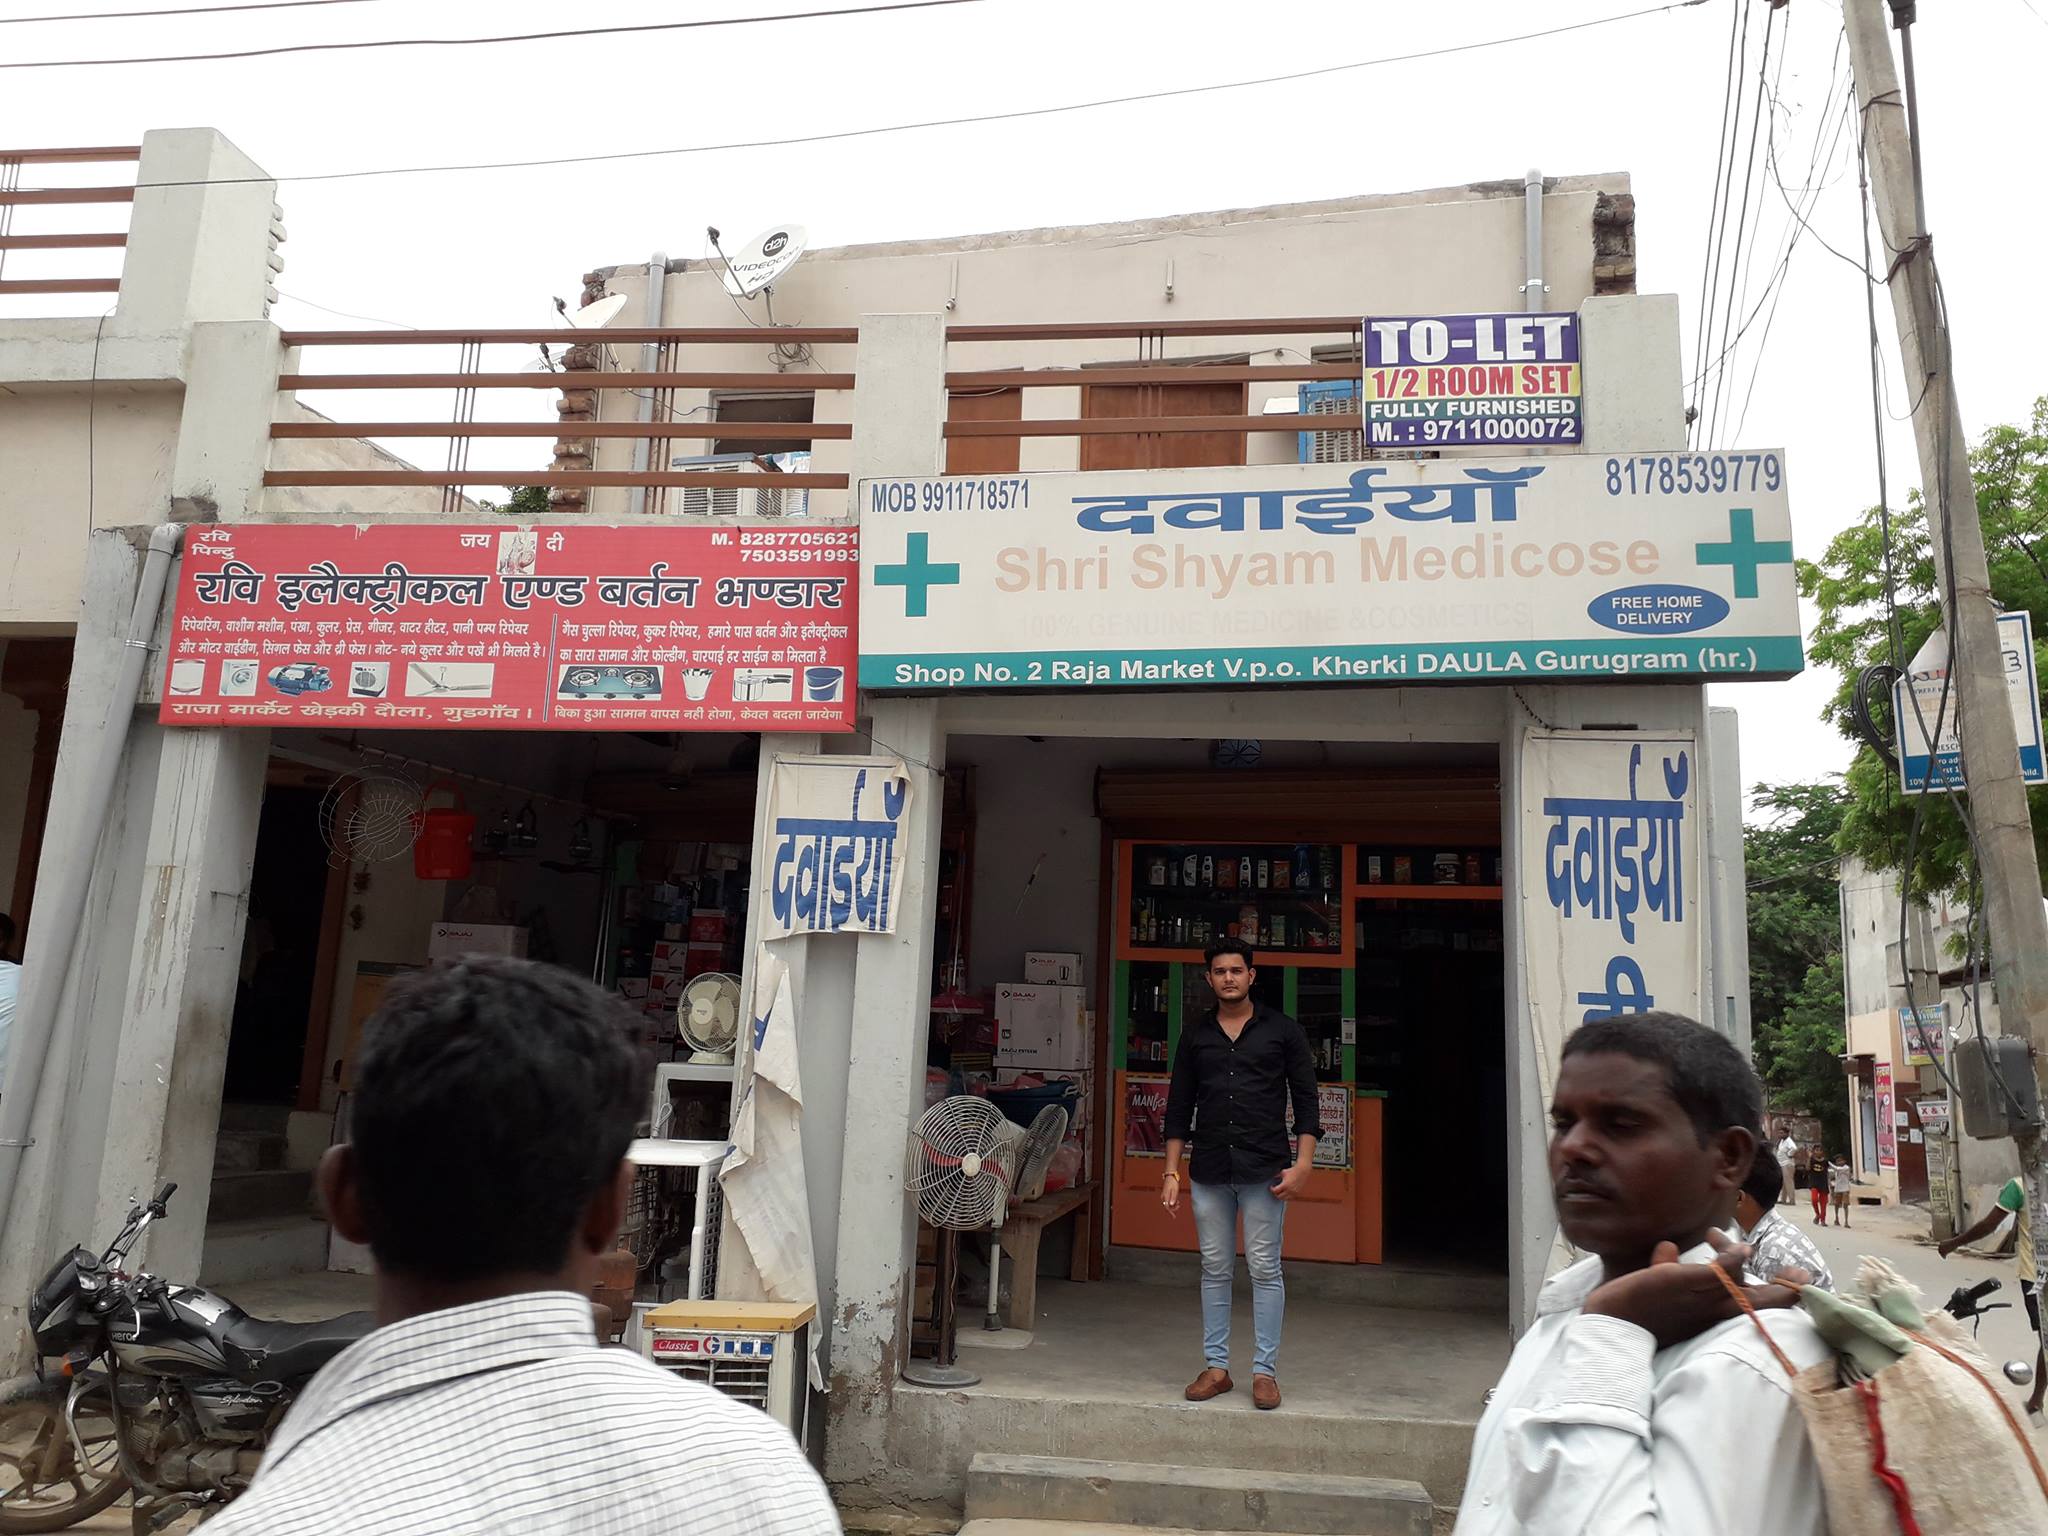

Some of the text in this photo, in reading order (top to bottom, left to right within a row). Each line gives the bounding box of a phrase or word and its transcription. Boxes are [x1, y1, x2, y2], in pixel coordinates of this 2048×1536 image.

[1371, 316, 1571, 364] TO-LET
[1372, 364, 1573, 398] 1/2 ROOM SET
[1370, 399, 1576, 418] FULLY FURNISHED
[1423, 418, 1576, 441] 9711000072
[1606, 453, 1780, 496] 8178539779
[872, 479, 1029, 513] MOB 9911718571
[199, 529, 232, 543] रवि
[460, 533, 492, 549] जय
[740, 532, 858, 546] 8287705621
[740, 549, 859, 562] 7503591993
[995, 534, 1660, 600] Shri Shyam Medicose
[194, 561, 265, 604] रवि
[502, 575, 588, 610] एण्ड
[597, 561, 700, 609] बर्तन
[715, 576, 846, 609] भण्डार
[1612, 595, 1703, 610] FREE HOME
[453, 618, 473, 634] पानी
[1616, 611, 1693, 626] DELIVERY
[708, 620, 731, 639] हमारे
[734, 625, 752, 638] पास
[755, 620, 777, 639] बर्तन
[780, 620, 798, 639] और
[178, 638, 195, 653] और
[198, 638, 222, 653] मोटर
[313, 640, 331, 655] और
[446, 641, 464, 656] और
[488, 641, 500, 657] भी
[502, 641, 530, 657] मिलते
[560, 648, 572, 662] का
[575, 648, 595, 662] सारा
[598, 648, 627, 662] सामान
[631, 645, 648, 662] और
[727, 650, 739, 663] हर
[772, 650, 784, 663] का
[787, 645, 817, 663] मिलता
[895, 647, 1757, 688] Shop No. 2 Raja Market V.p.o. Kherki DAULA Gurugram (hr.)
[172, 702, 221, 715] राजा
[229, 700, 292, 715] मार्केट
[555, 704, 579, 719] बिका
[583, 707, 606, 722] हुआ
[611, 708, 646, 719] सामान
[650, 708, 680, 720] वापस
[740, 706, 768, 720] केवल
[772, 709, 802, 720] बदला
[806, 706, 843, 720] जायेगा
[658, 1340, 694, 1351] Classic
